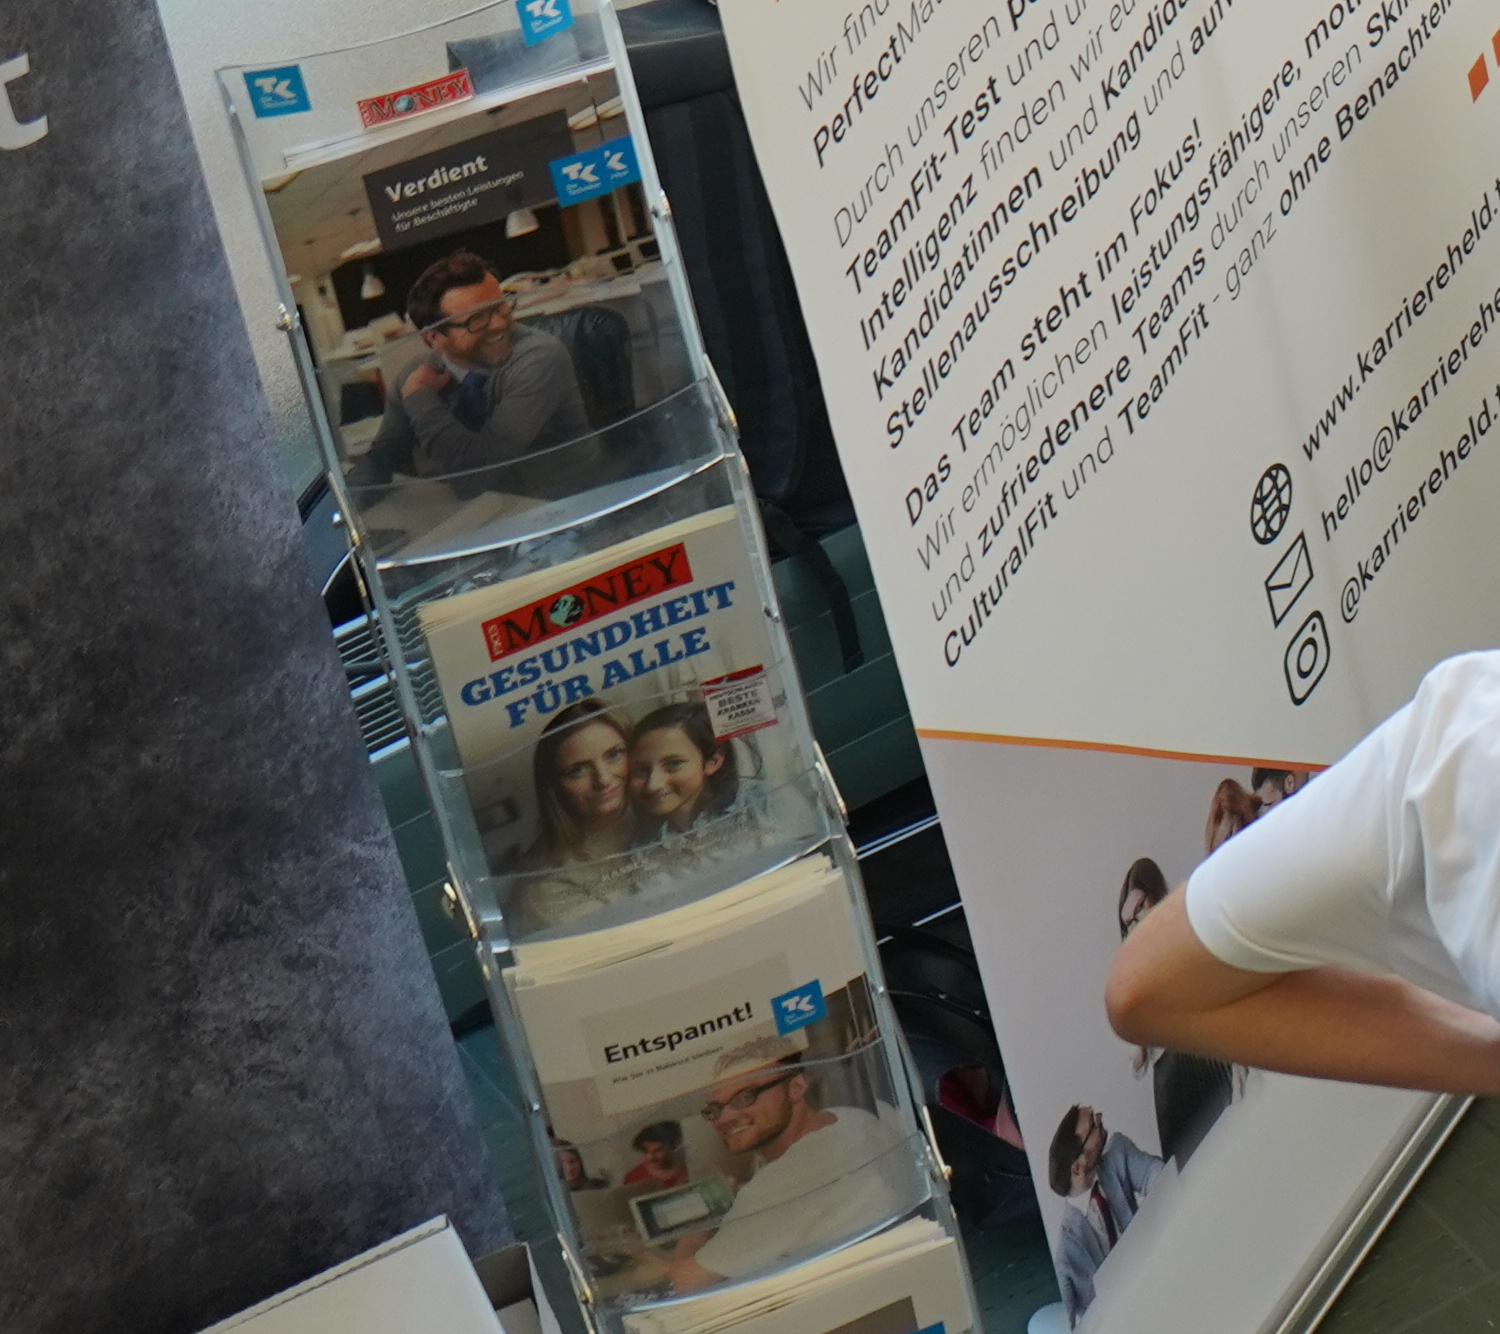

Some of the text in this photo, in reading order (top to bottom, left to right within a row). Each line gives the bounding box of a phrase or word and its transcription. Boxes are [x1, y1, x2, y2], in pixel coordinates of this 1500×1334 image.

[385, 155, 489, 202] Verdient
[798, 45, 839, 112] Wir
[832, 142, 903, 250] Durch
[906, 15, 1000, 148] unseren
[845, 76, 1002, 296] TeamFit-Test
[1005, 17, 1061, 88] und
[859, 173, 978, 352] Intelligenz
[979, 76, 1066, 180] finden
[1069, 24, 1107, 85] wir
[872, 164, 1043, 401] Kandidatinnen
[1049, 94, 1100, 172] und
[885, 109, 1142, 449] Stellenausschreibung
[1143, 34, 1185, 117] und
[904, 117, 1203, 527] Das Team steht im Fokus!
[916, 507, 956, 572] Wir
[961, 319, 1108, 513] ermöglichen
[1110, 60, 1302, 325] leistungsfähigere,
[931, 550, 975, 623] und
[977, 355, 1132, 557] zufriedenere
[1131, 247, 1206, 357] Teams
[1210, 159, 1270, 252] durch
[1272, 43, 1362, 164] unseren
[943, 492, 1058, 669] CulturalFit
[1062, 427, 1115, 502] und
[1117, 302, 1210, 437] TeamFit
[1225, 213, 1278, 301] ganz
[1279, 136, 1332, 217] ohne
[461, 580, 736, 707] GESUNDHEIT
[502, 548, 682, 652] MONEY
[505, 626, 711, 730] FÜR ALLE
[604, 1002, 754, 1064] Entspannt!
